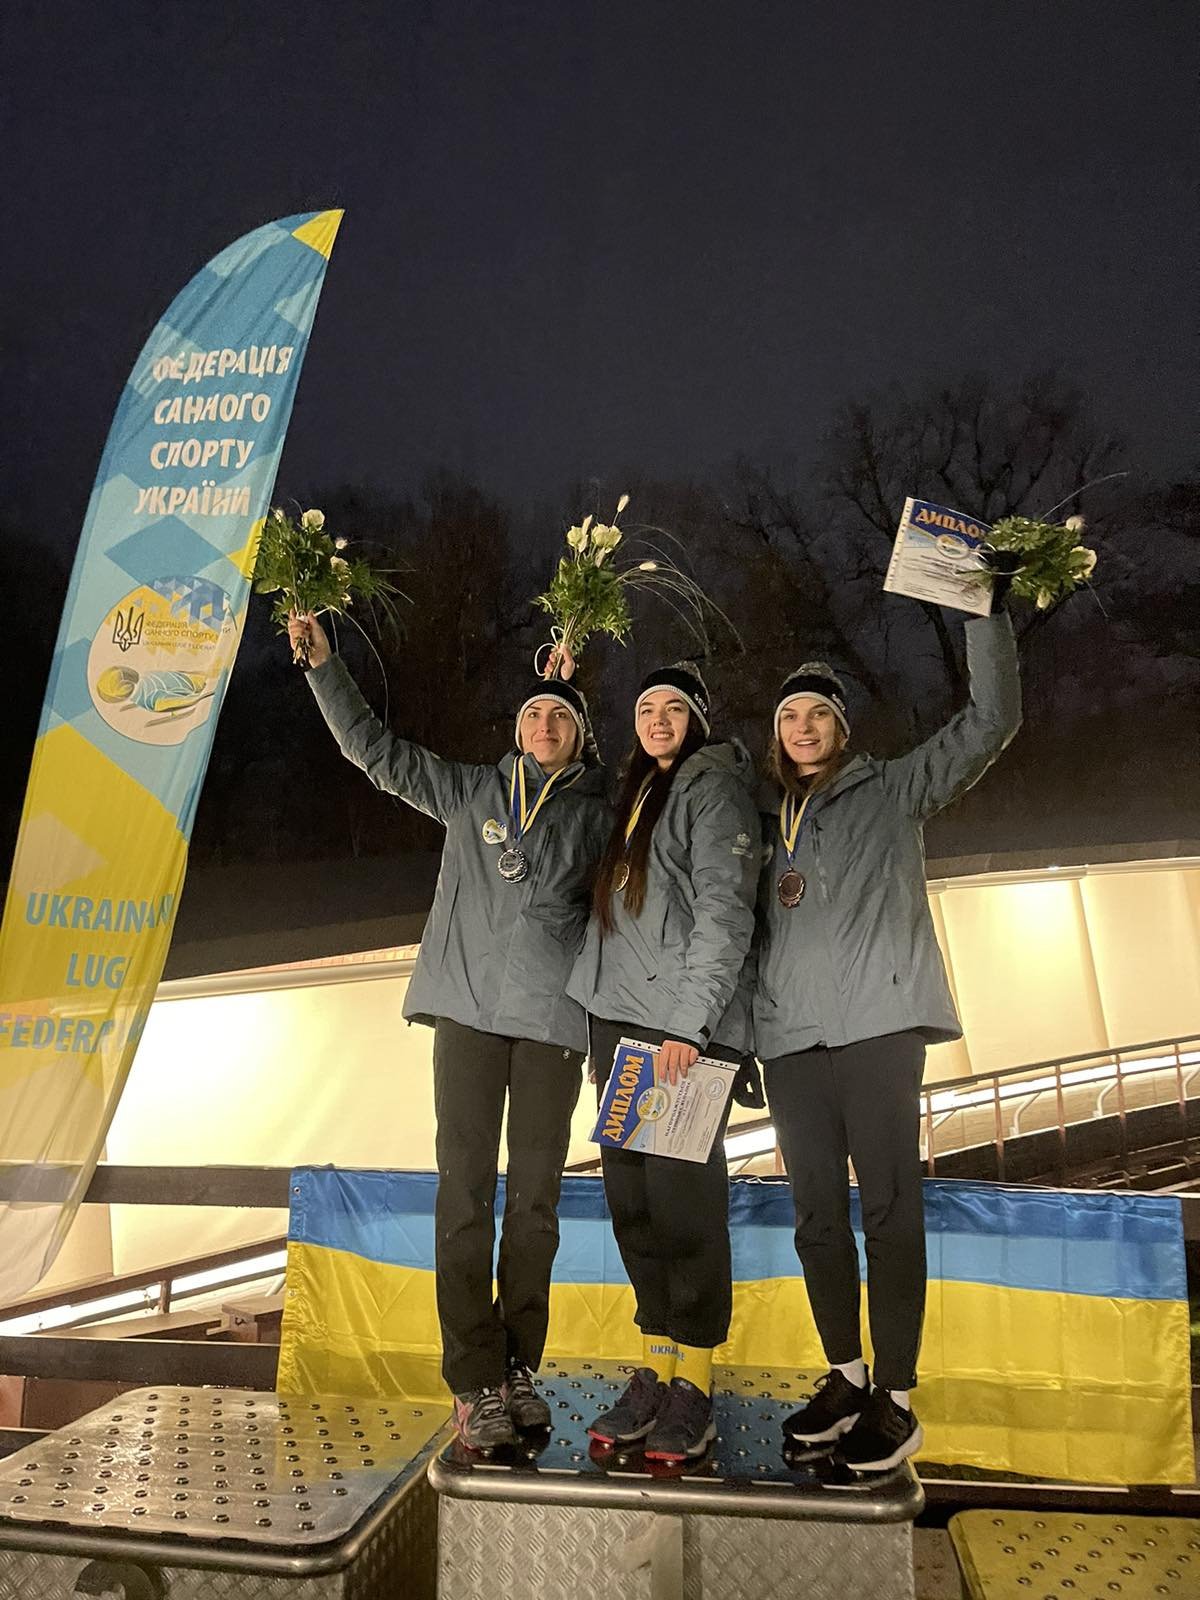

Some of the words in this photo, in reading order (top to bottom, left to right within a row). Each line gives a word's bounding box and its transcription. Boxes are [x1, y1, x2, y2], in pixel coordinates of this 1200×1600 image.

[150, 438, 255, 470] СПОРТУ
[133, 480, 250, 516] УКРАЇНИ
[915, 508, 985, 538] ДИПЛО
[65, 953, 126, 989] LUG
[602, 1055, 645, 1142] ДИПЛОМ
